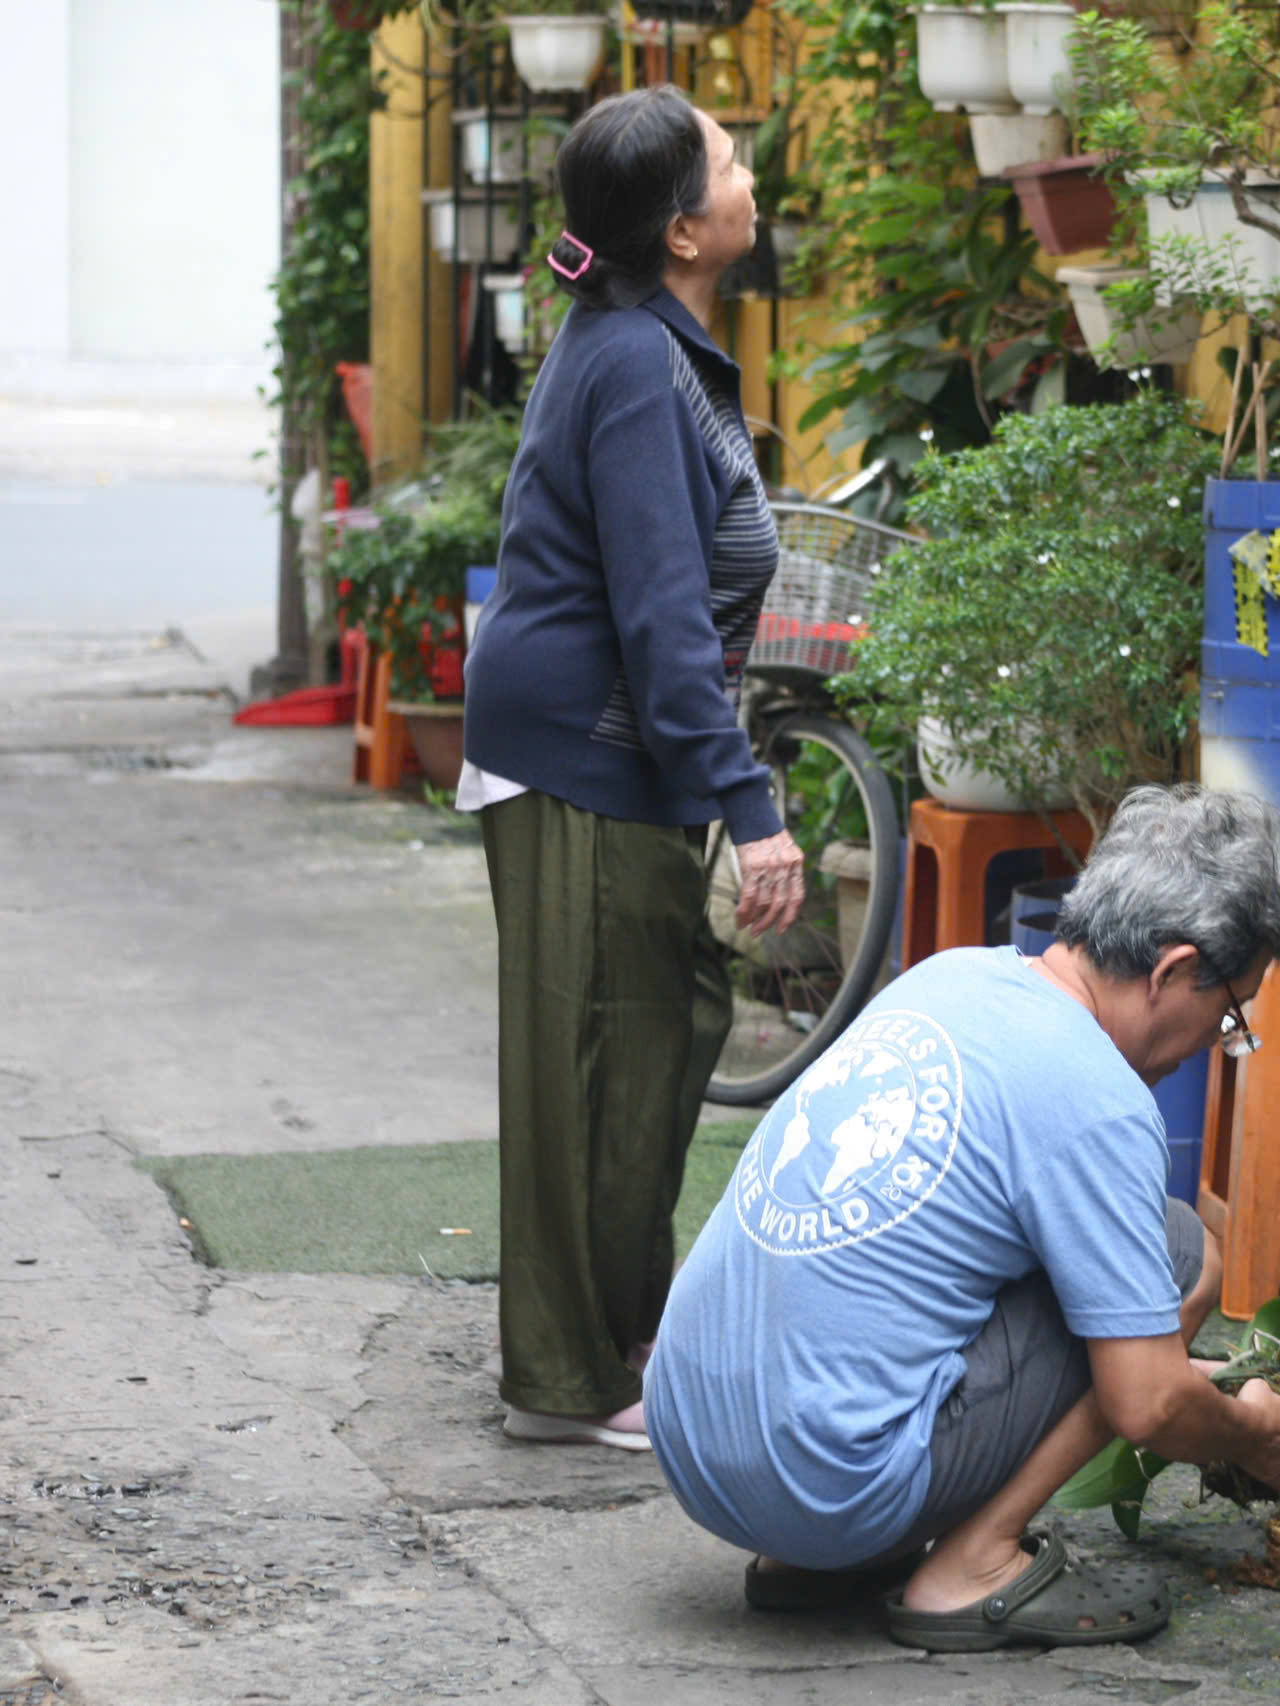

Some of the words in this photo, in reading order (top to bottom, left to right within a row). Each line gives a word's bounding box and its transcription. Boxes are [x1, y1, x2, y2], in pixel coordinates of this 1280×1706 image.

[914, 1063, 951, 1143] FOR
[741, 1132, 763, 1212] THE
[759, 1196, 871, 1242] WORLD
